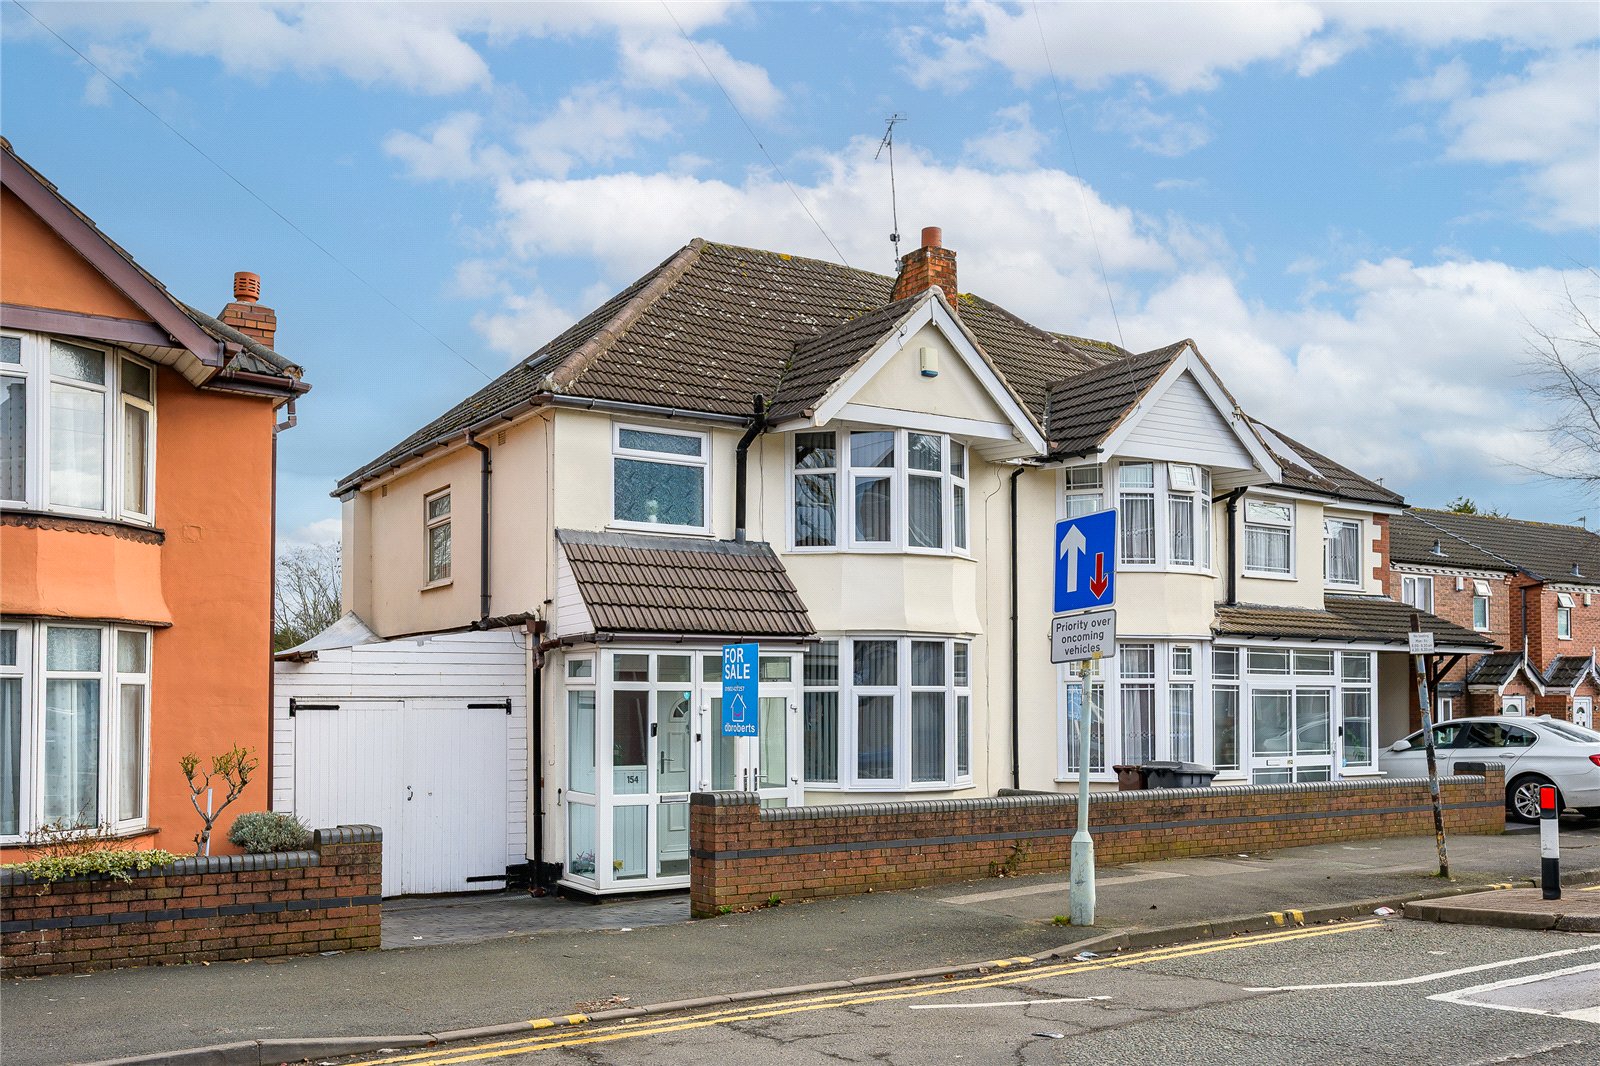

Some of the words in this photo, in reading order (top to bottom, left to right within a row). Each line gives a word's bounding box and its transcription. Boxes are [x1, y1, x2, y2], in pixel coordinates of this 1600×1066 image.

[1056, 620, 1088, 632] Priority
[1091, 618, 1111, 627] over
[1061, 631, 1104, 643] oncoming
[724, 647, 744, 663] FOR
[1064, 643, 1101, 655] vehicles
[724, 663, 751, 679] SALE
[724, 722, 756, 733] dbroberts
[627, 775, 639, 784] 154
